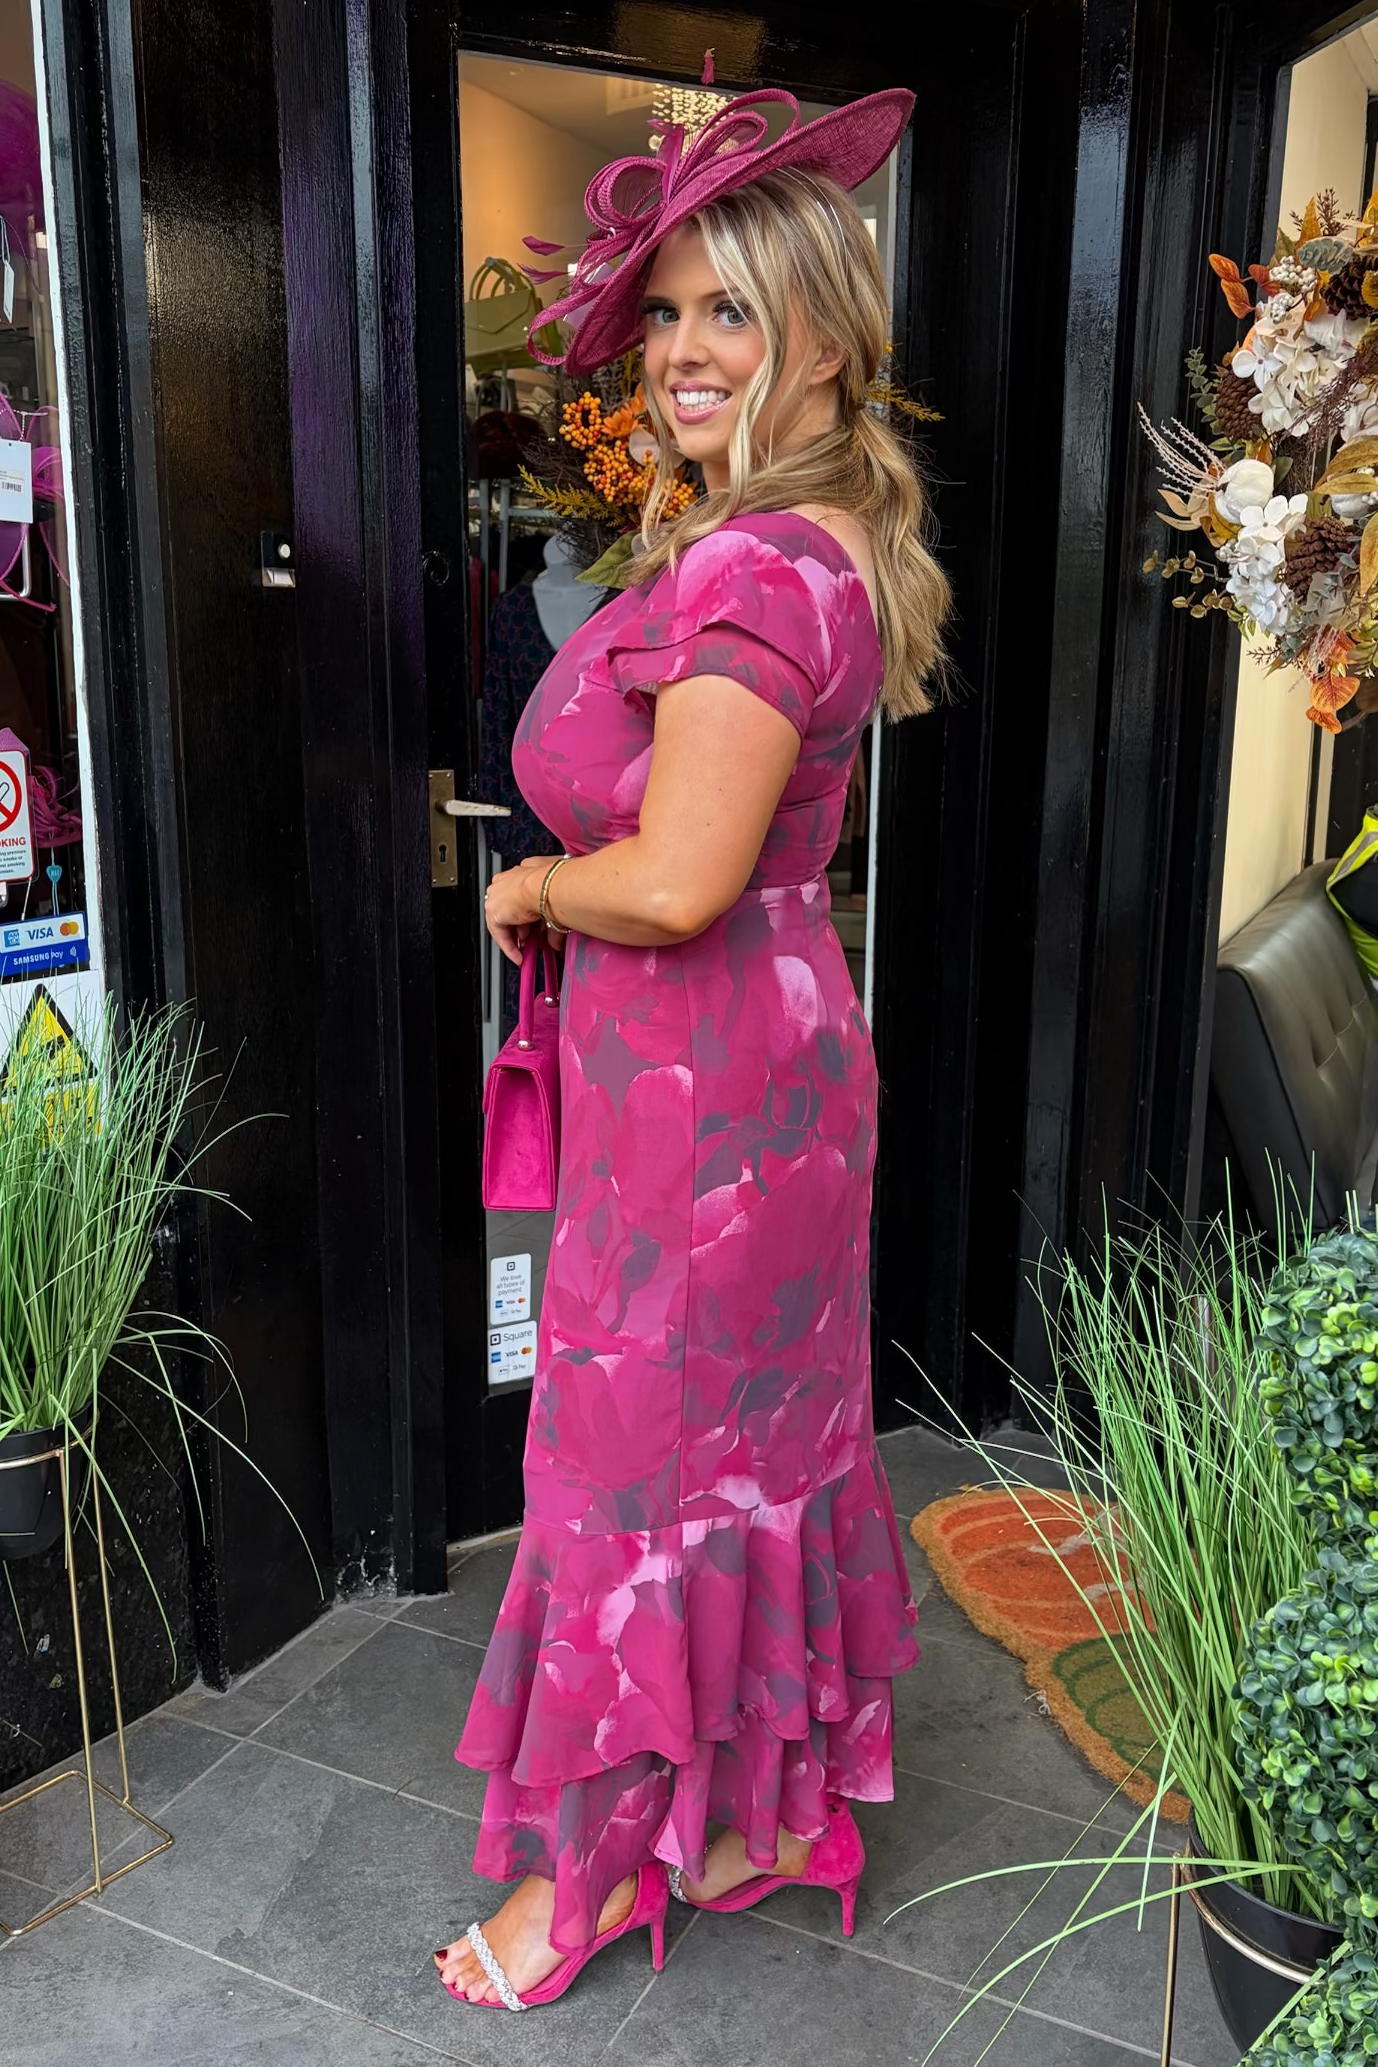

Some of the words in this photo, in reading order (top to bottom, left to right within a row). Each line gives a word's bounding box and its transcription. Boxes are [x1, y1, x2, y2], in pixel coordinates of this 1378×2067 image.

[0, 836, 26, 847] KING
[26, 926, 54, 940] VISA
[13, 952, 50, 966] SAMSUNG
[497, 1286, 523, 1296] payment
[503, 1329, 533, 1342] Square
